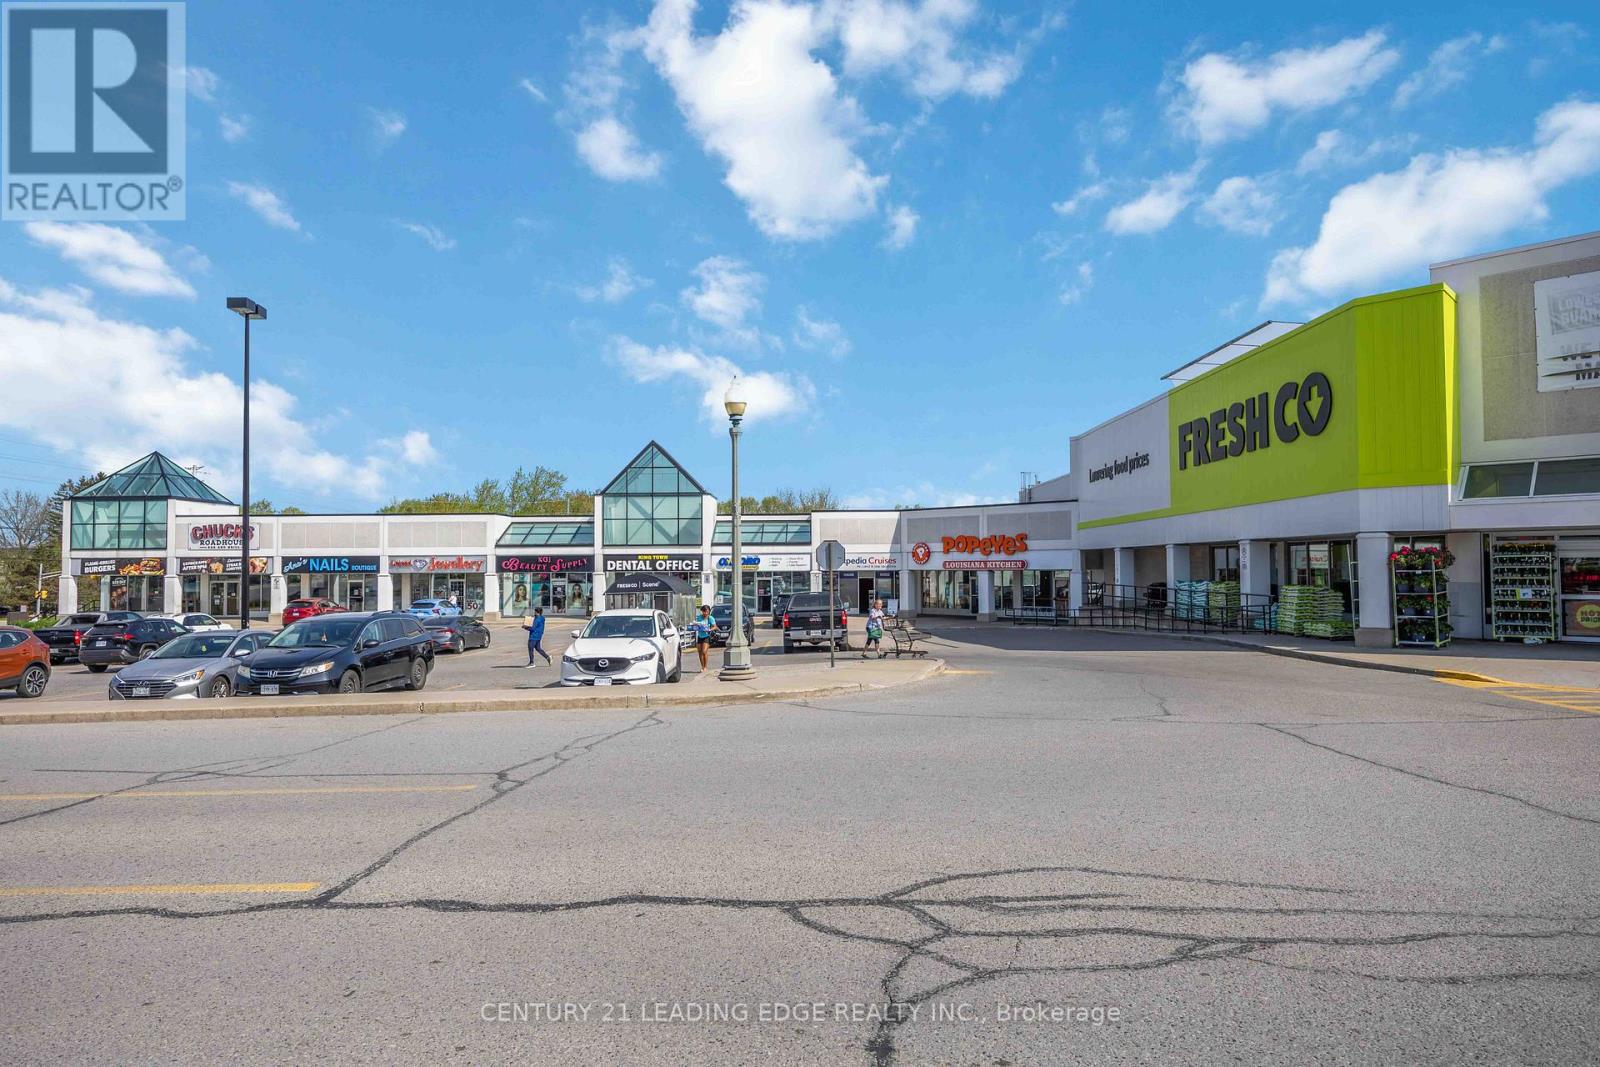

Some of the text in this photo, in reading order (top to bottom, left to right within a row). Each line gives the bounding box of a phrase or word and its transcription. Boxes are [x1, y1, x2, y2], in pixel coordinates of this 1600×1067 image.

[1114, 455, 1129, 476] food
[1129, 452, 1150, 475] prices
[309, 558, 349, 571] NAILS
[607, 560, 700, 571] DENTAL OFFICE
[845, 556, 867, 566] pedia
[868, 556, 897, 564] Cruises
[945, 561, 985, 569] LOUISIANA
[84, 564, 116, 574] BURGERS
